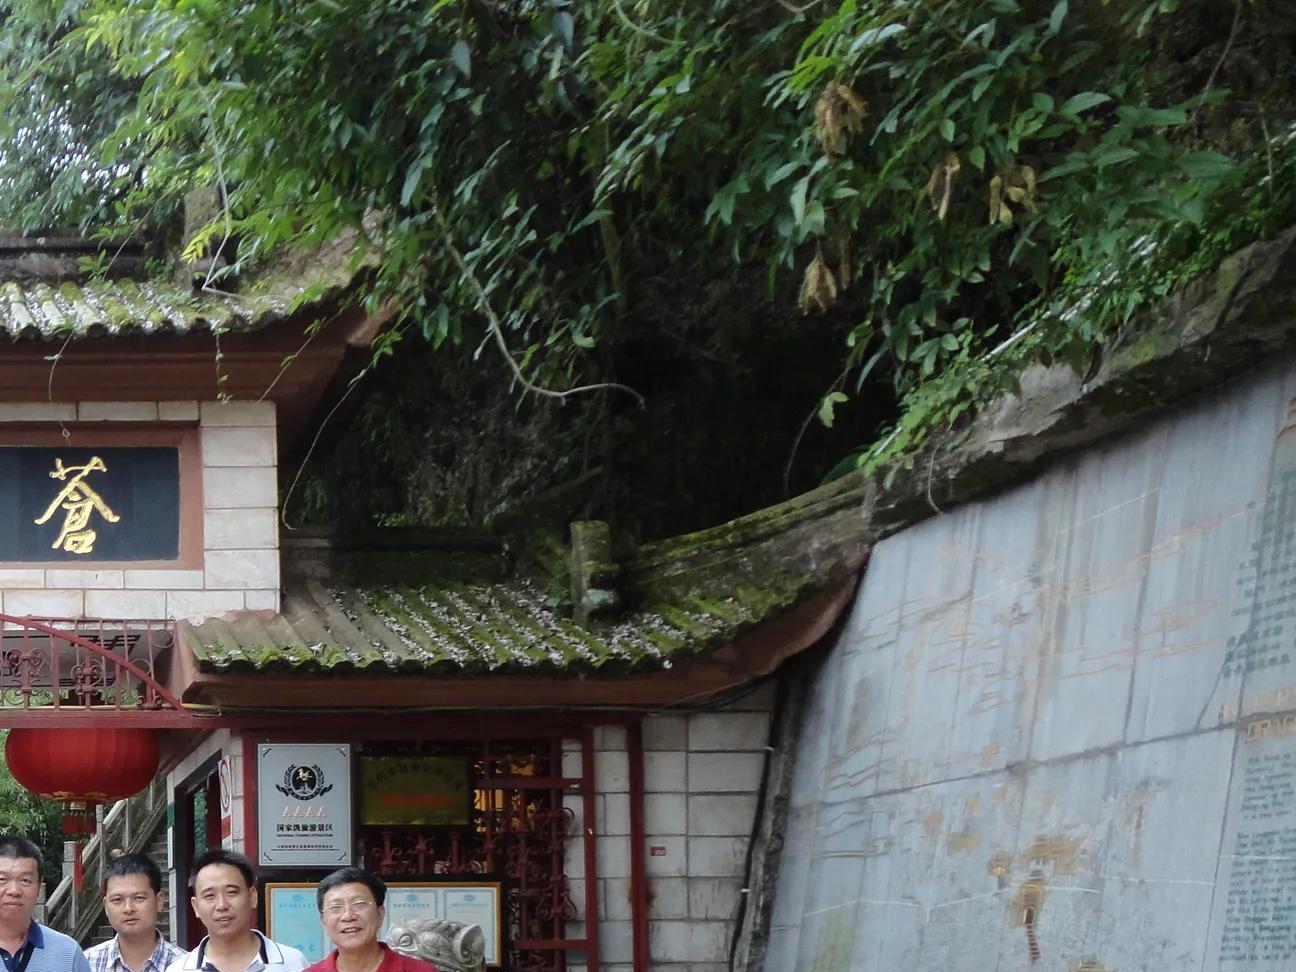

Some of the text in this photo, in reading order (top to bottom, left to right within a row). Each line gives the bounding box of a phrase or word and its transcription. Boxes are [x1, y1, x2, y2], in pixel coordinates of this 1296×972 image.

[276, 824, 333, 832] 国家级旅游景区
